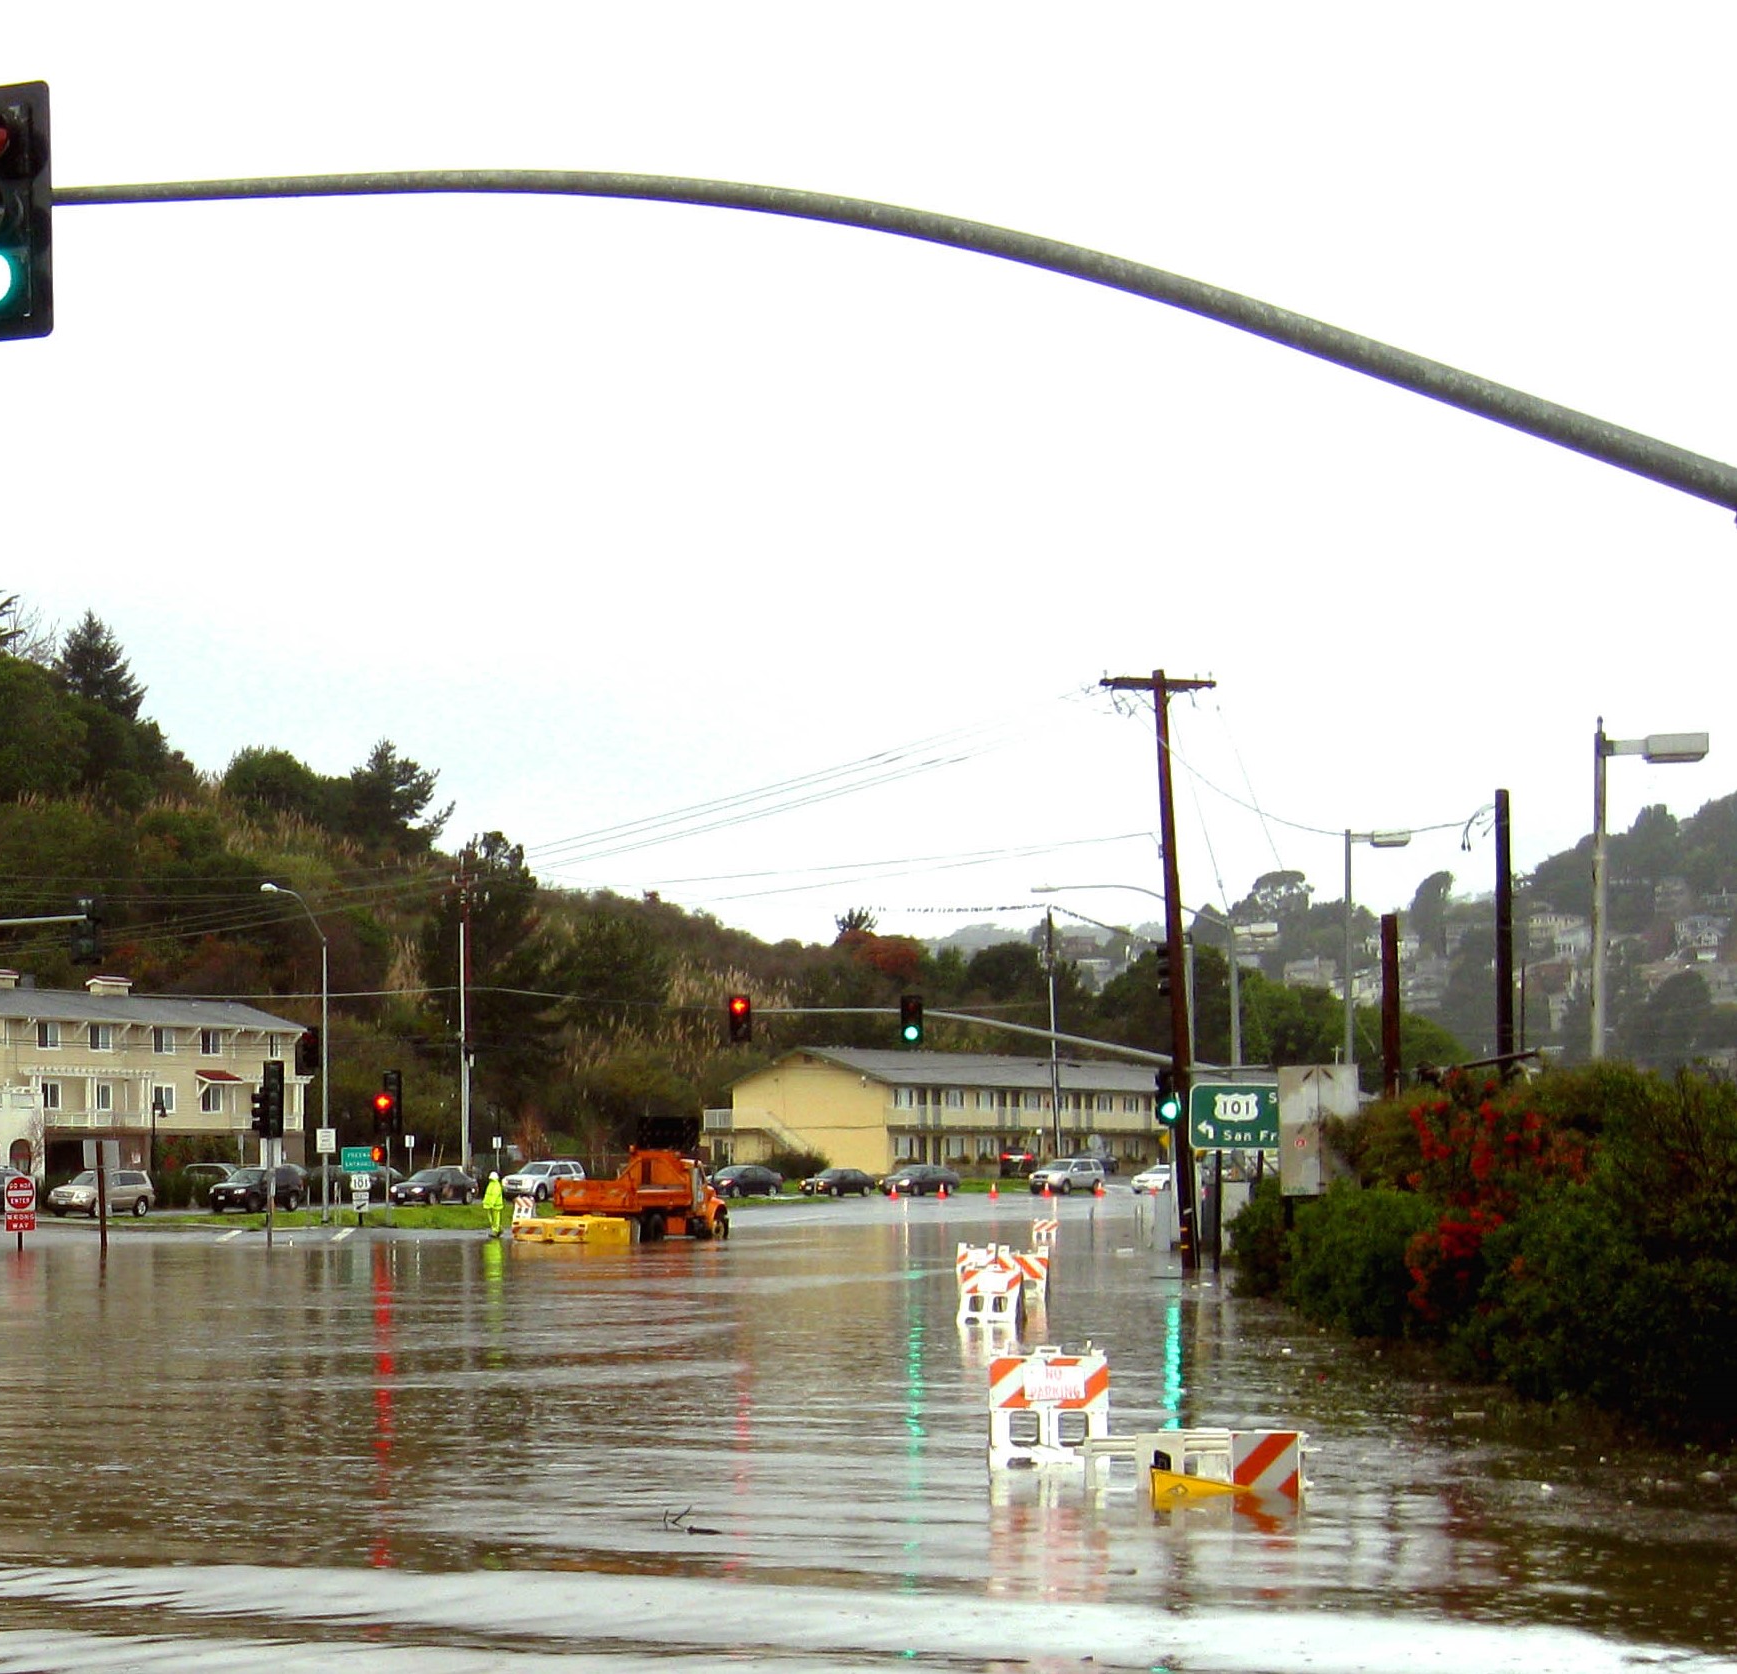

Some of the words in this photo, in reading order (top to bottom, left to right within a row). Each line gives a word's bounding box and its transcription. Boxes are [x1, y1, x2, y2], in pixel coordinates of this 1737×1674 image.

[1268, 1092, 1277, 1104] S
[1222, 1102, 1250, 1115] 101
[1223, 1130, 1252, 1142] San
[1259, 1130, 1280, 1142] Fr
[353, 1179, 368, 1189] 101
[1045, 1367, 1062, 1380] NO
[1030, 1385, 1081, 1399] PARKING
